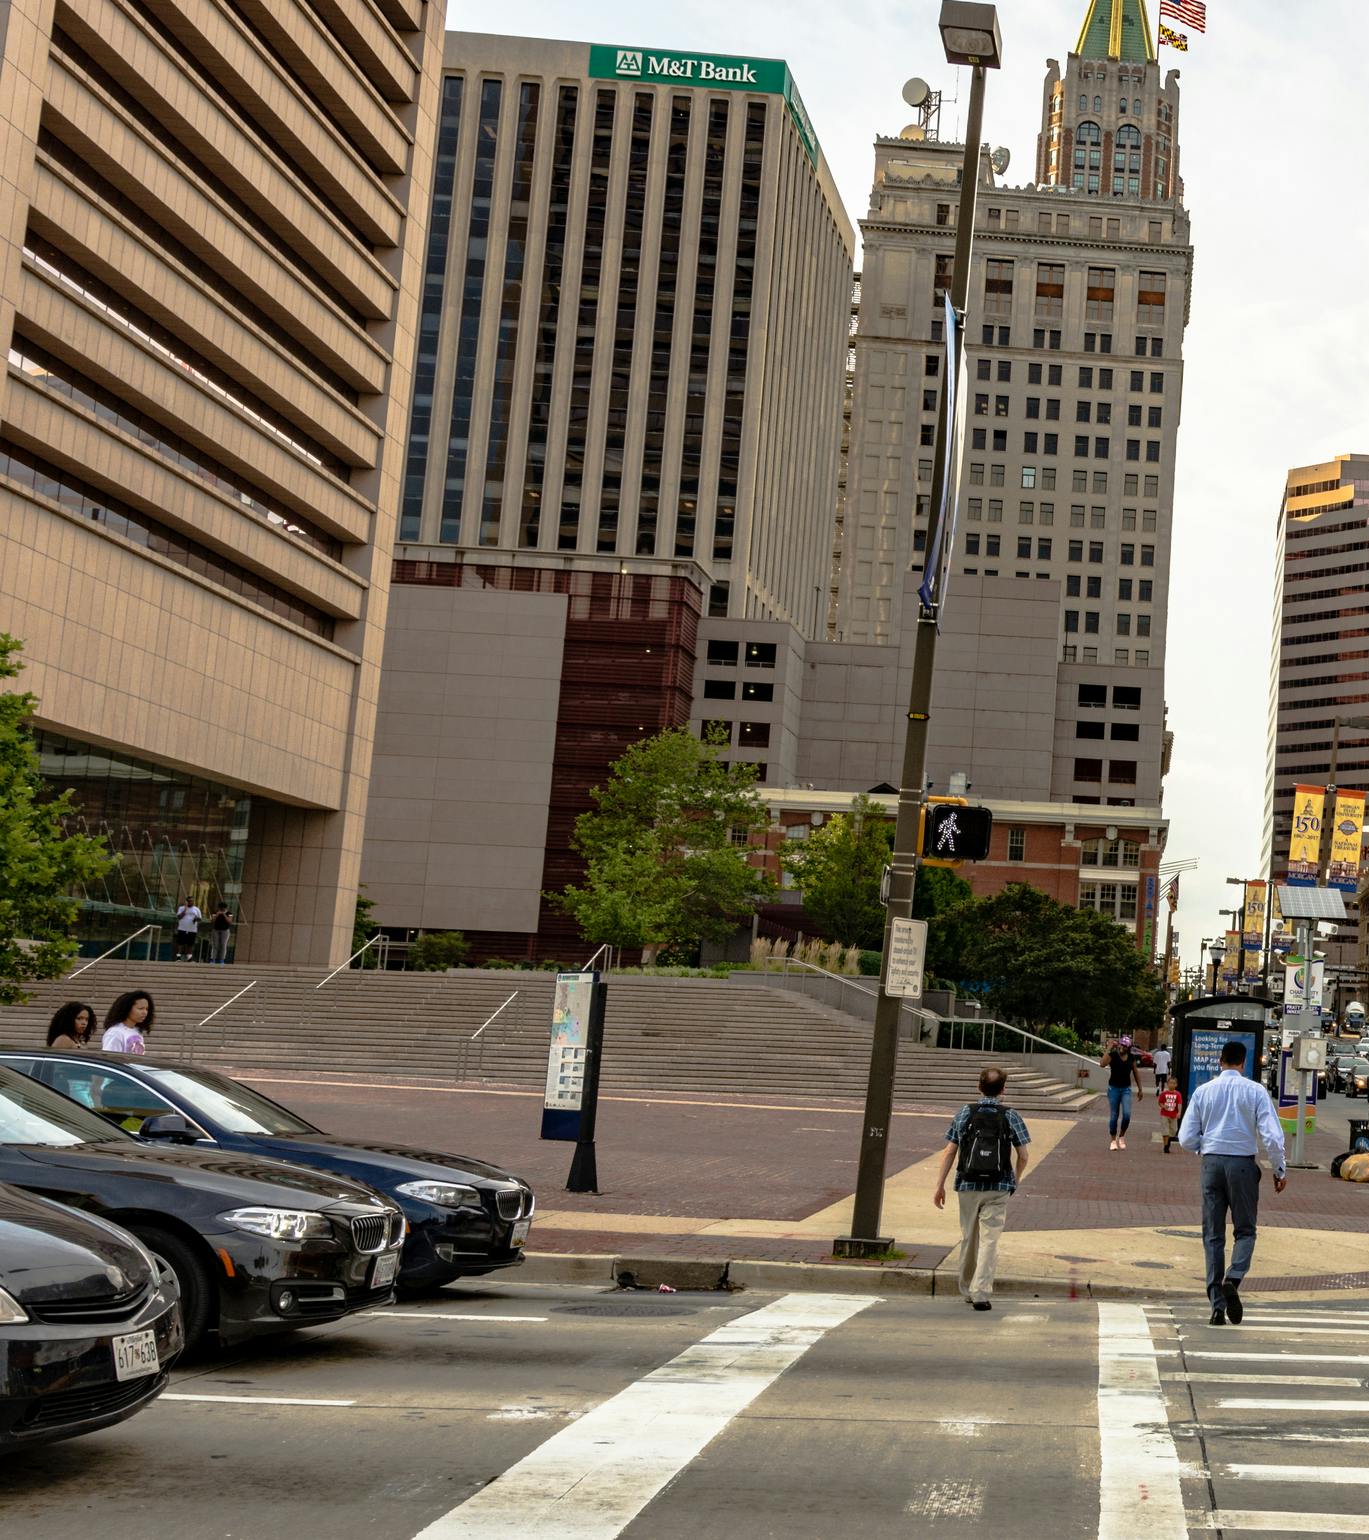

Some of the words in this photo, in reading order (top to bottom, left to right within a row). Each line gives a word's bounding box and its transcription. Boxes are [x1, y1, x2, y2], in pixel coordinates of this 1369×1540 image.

[647, 56, 697, 78] M&T
[699, 63, 758, 84] Bank
[1295, 816, 1320, 833] 150
[1247, 902, 1266, 912] 150
[1195, 1035, 1217, 1043] Looking
